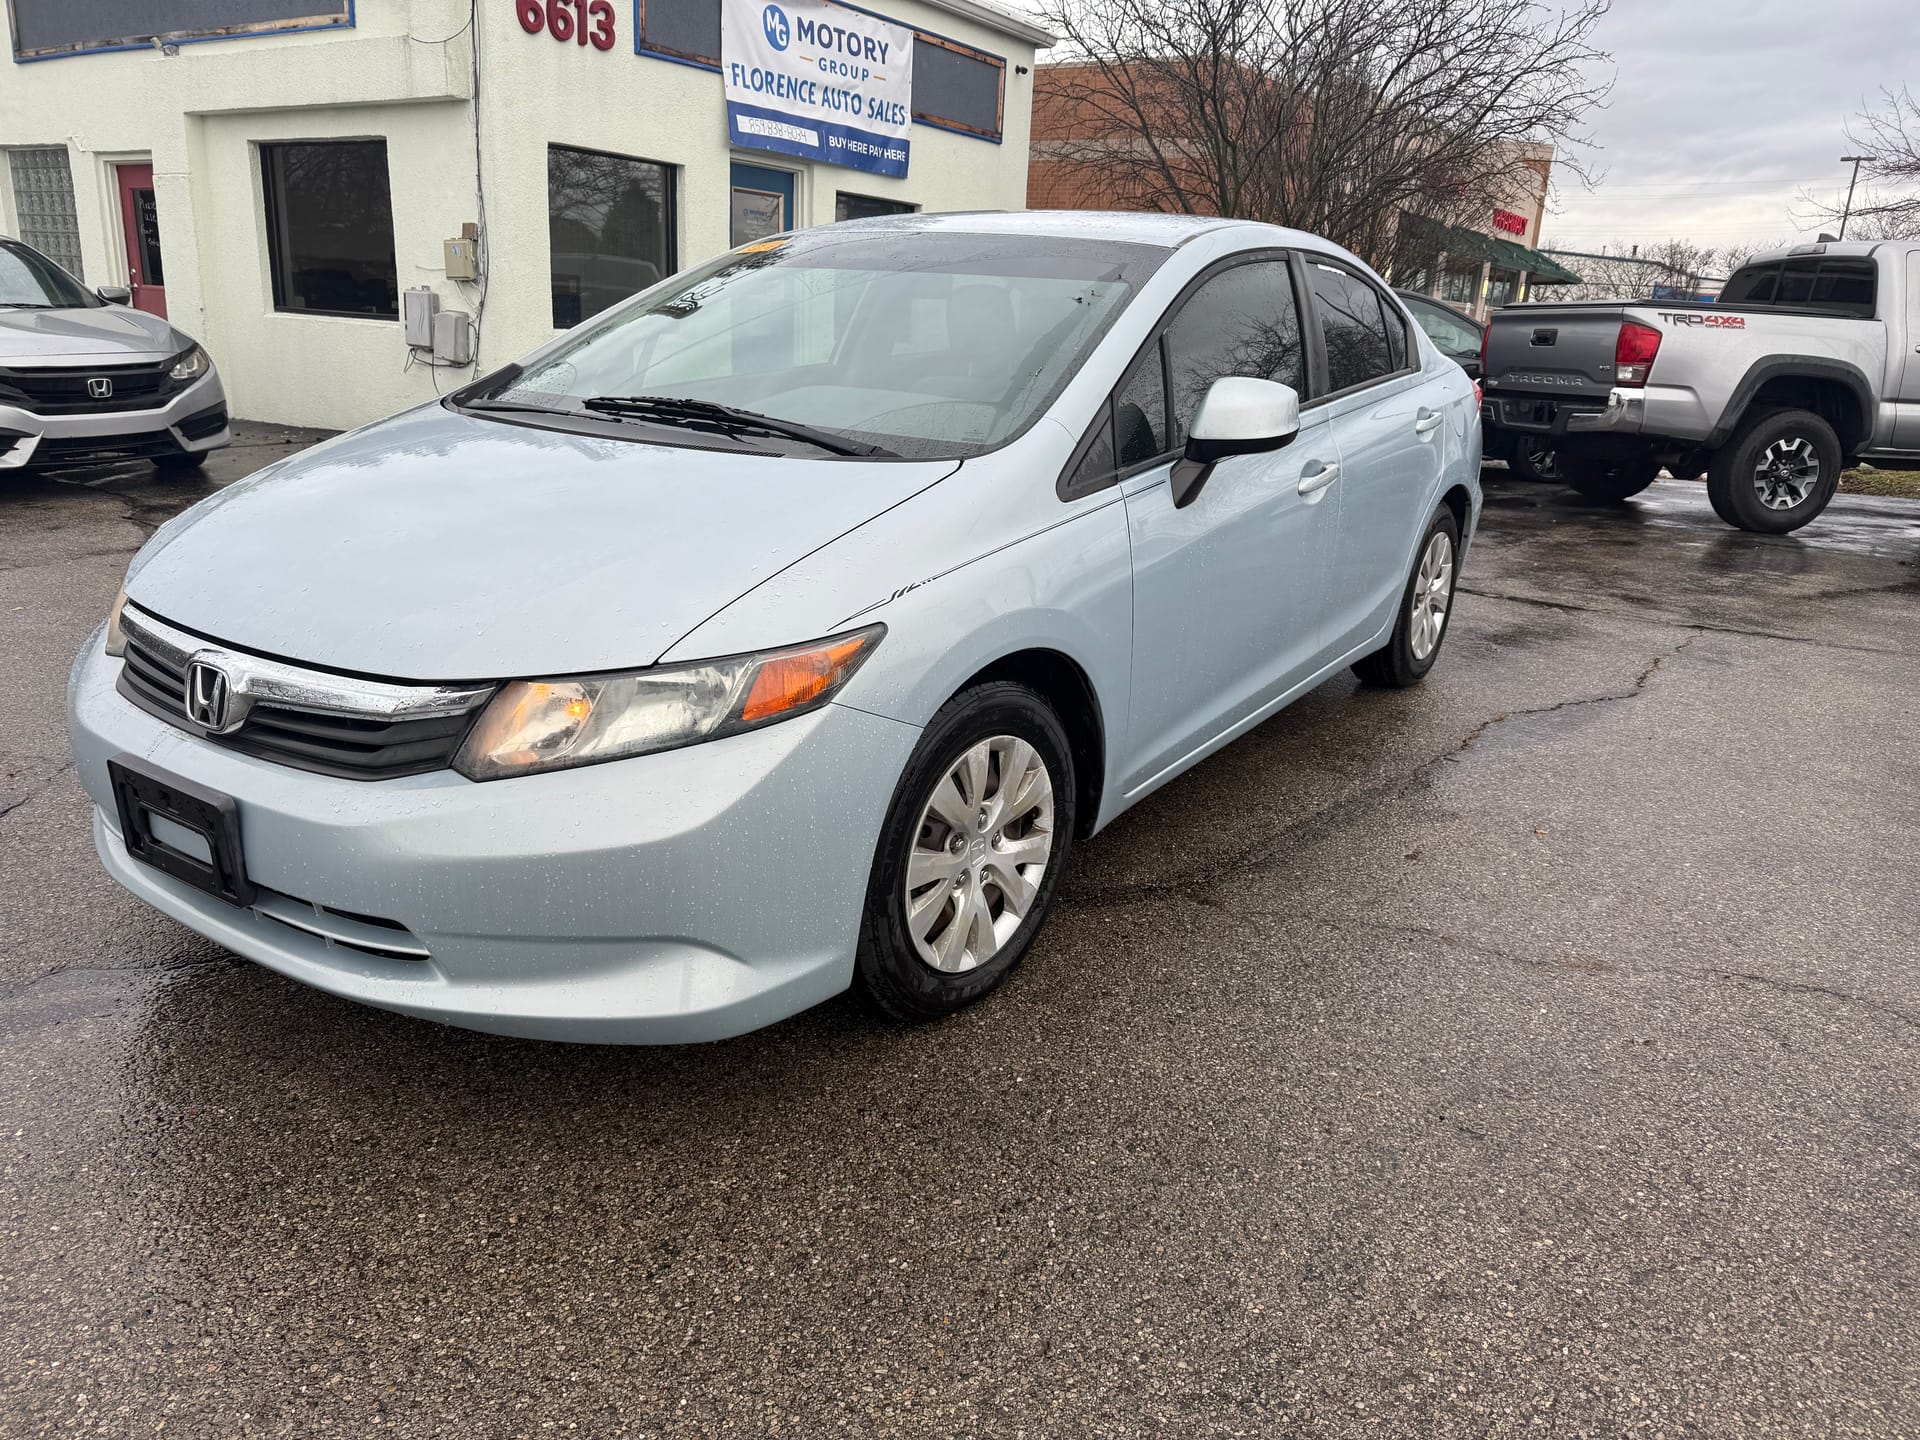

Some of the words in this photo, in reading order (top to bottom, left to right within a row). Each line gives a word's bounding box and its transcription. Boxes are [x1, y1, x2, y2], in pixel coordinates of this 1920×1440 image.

[516, 0, 615, 51] 6613
[796, 16, 889, 65] MOTORY
[818, 57, 869, 82] GROUP
[731, 63, 816, 105] FLORENCE
[821, 86, 862, 116] AUTO
[867, 97, 906, 126] SALES
[828, 135, 847, 149] BUY
[847, 139, 868, 155] HERE
[868, 144, 883, 158] PAY
[883, 148, 906, 162] HERE
[1657, 312, 1704, 327] TRD
[1508, 373, 1583, 386] TACOMA
